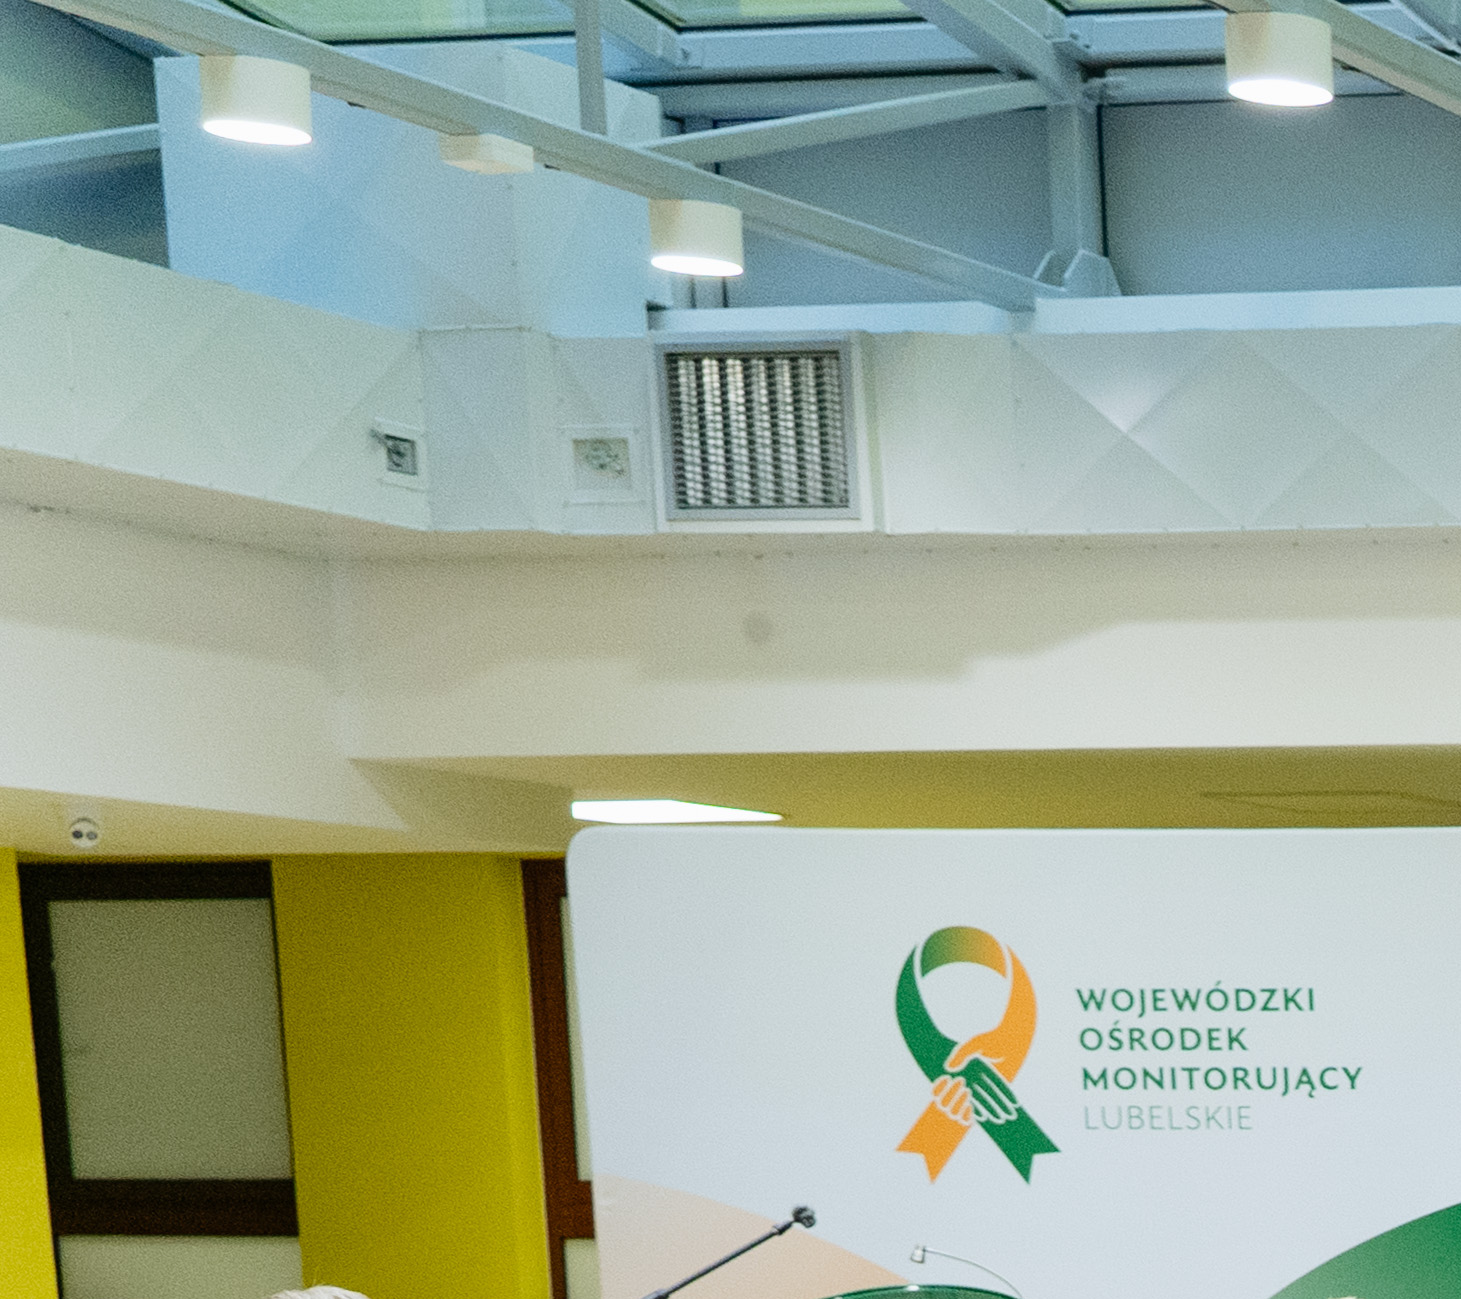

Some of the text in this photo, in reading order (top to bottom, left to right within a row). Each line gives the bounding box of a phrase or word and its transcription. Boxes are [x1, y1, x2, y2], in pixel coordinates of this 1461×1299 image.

[1076, 980, 1316, 1018] WOJEWÓDZKI
[1078, 1019, 1249, 1051] OŚRODEK
[1082, 1065, 1364, 1098] MONITORUJĄCY
[1083, 1104, 1254, 1131] LUBELSKIE
